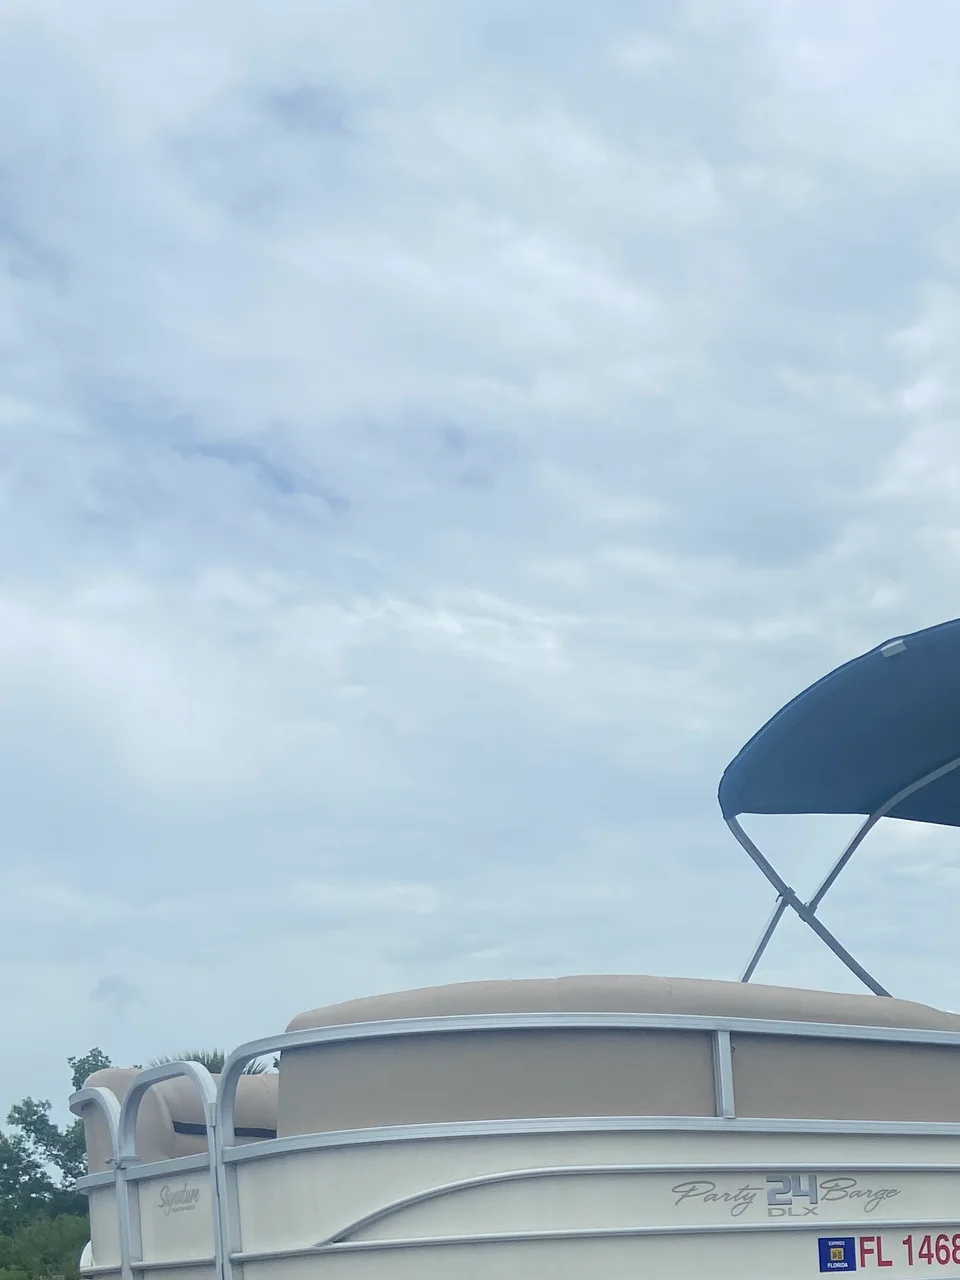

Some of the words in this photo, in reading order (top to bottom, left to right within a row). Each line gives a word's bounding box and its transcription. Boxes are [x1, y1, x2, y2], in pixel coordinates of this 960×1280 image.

[672, 1180, 764, 1217] Party
[766, 1174, 818, 1205] 24
[819, 1177, 901, 1213] Barge
[768, 1206, 819, 1217] DLX
[859, 1236, 893, 1267] FL
